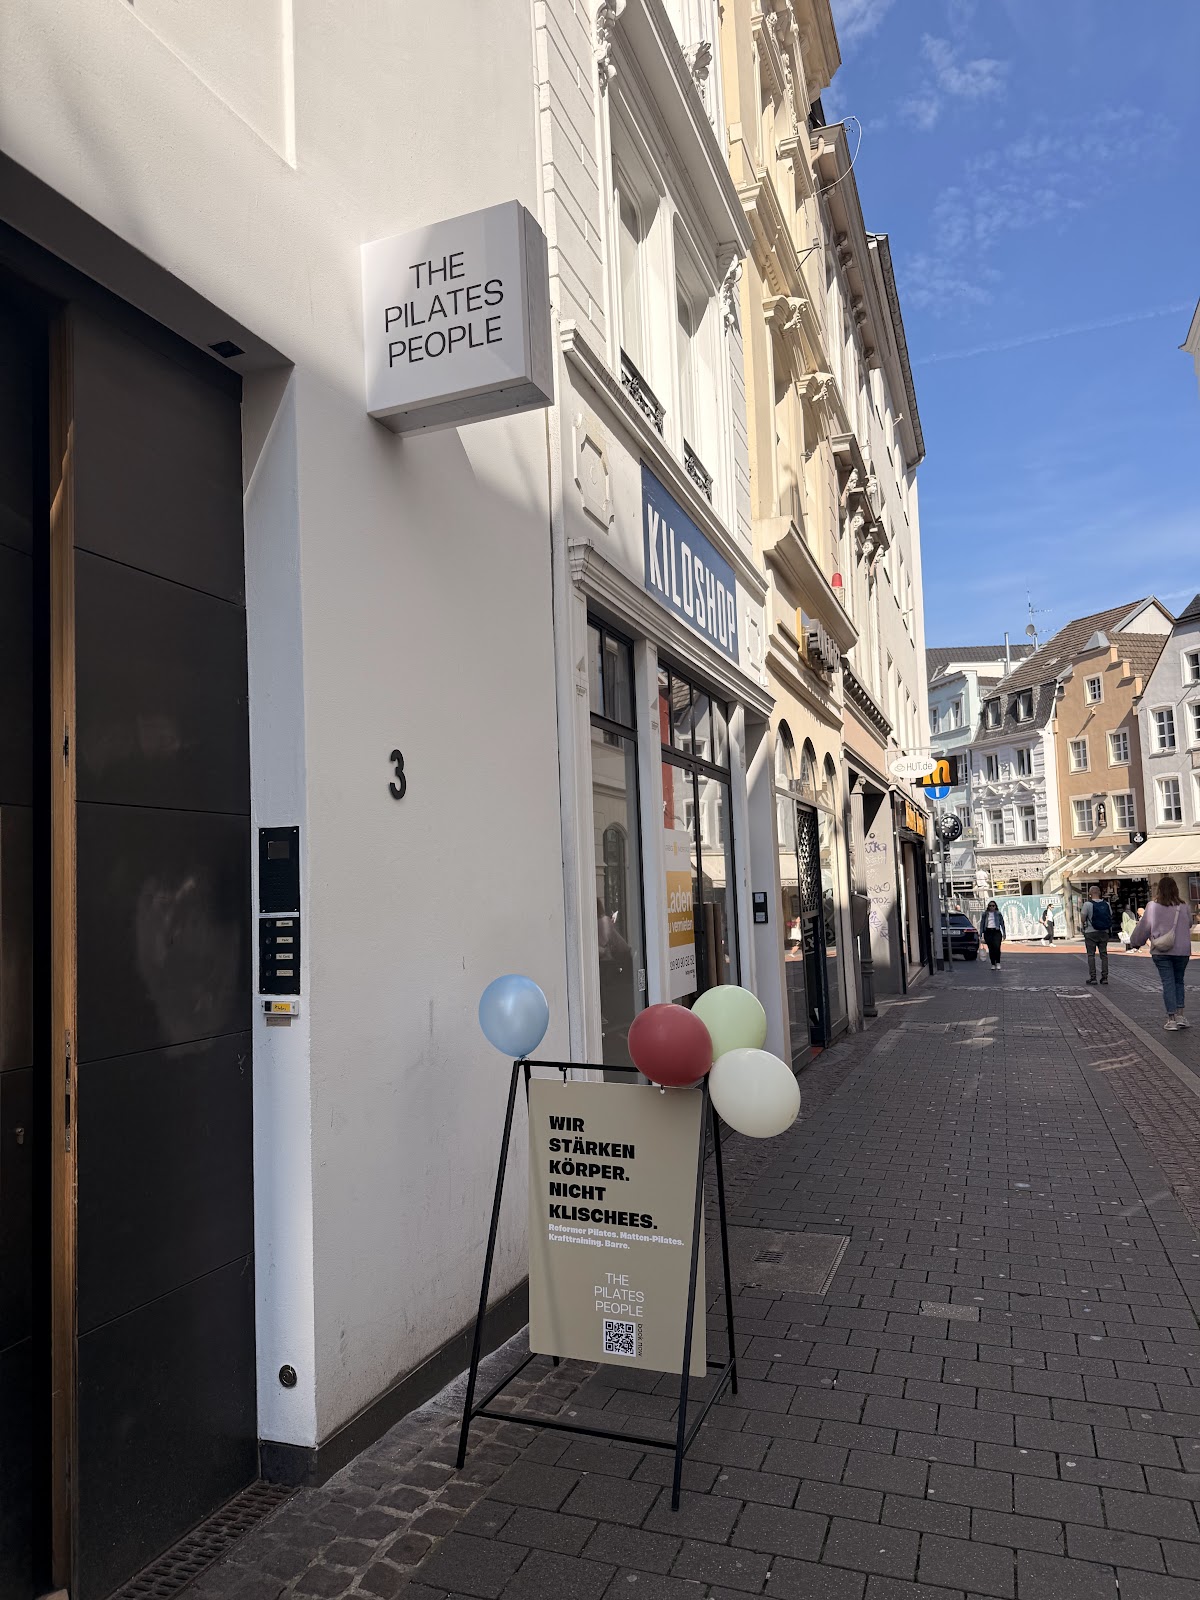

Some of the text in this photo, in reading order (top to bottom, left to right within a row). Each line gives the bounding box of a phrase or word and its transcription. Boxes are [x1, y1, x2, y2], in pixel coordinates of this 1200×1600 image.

[409, 251, 465, 289] THE
[385, 279, 504, 333] PILATES
[388, 315, 502, 368] PEOPLE
[647, 503, 736, 653] KILOSHOP
[389, 749, 407, 800] 3
[906, 762, 933, 772] HUT.de
[667, 885, 692, 914] aden
[549, 1115, 585, 1133] WIR
[548, 1136, 635, 1160] STÄRKEN
[549, 1157, 630, 1182] KÖRPER.
[549, 1181, 606, 1202] NICHT
[549, 1203, 658, 1230] KLISCHEES.
[549, 1224, 684, 1246] Reformer Pilates. Matten-Pilates.
[549, 1234, 630, 1250] Krafttraining. Barre.
[605, 1272, 629, 1287] THE
[594, 1285, 645, 1303] PILATES
[596, 1301, 643, 1317] PEOPLE
